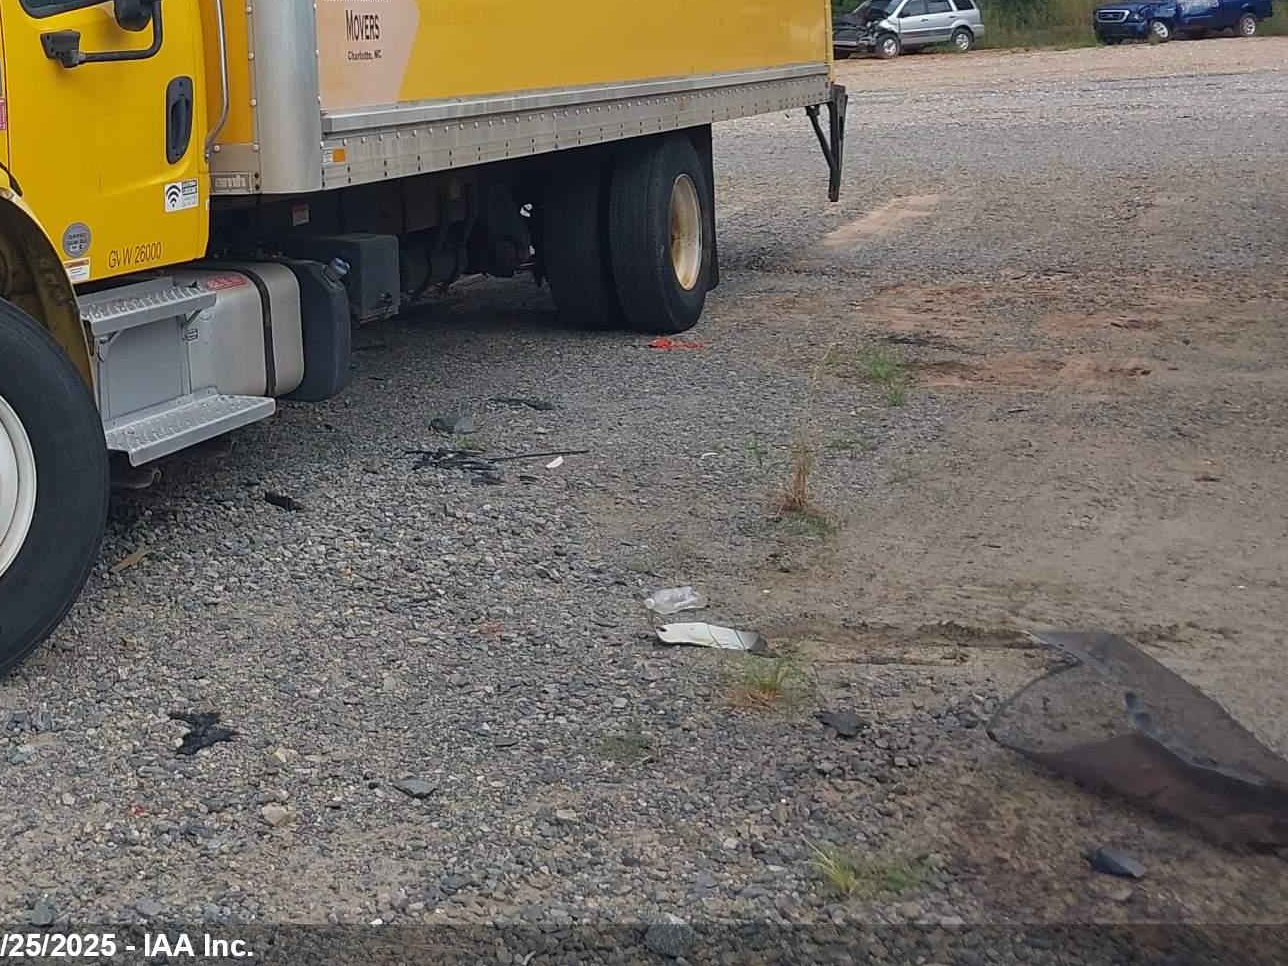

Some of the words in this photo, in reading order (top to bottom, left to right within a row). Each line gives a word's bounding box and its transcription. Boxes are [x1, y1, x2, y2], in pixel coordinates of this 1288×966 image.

[345, 9, 380, 41] MOVERS
[347, 50, 373, 62] Charlotte,
[374, 49, 382, 59] NC
[134, 241, 162, 264] 26000
